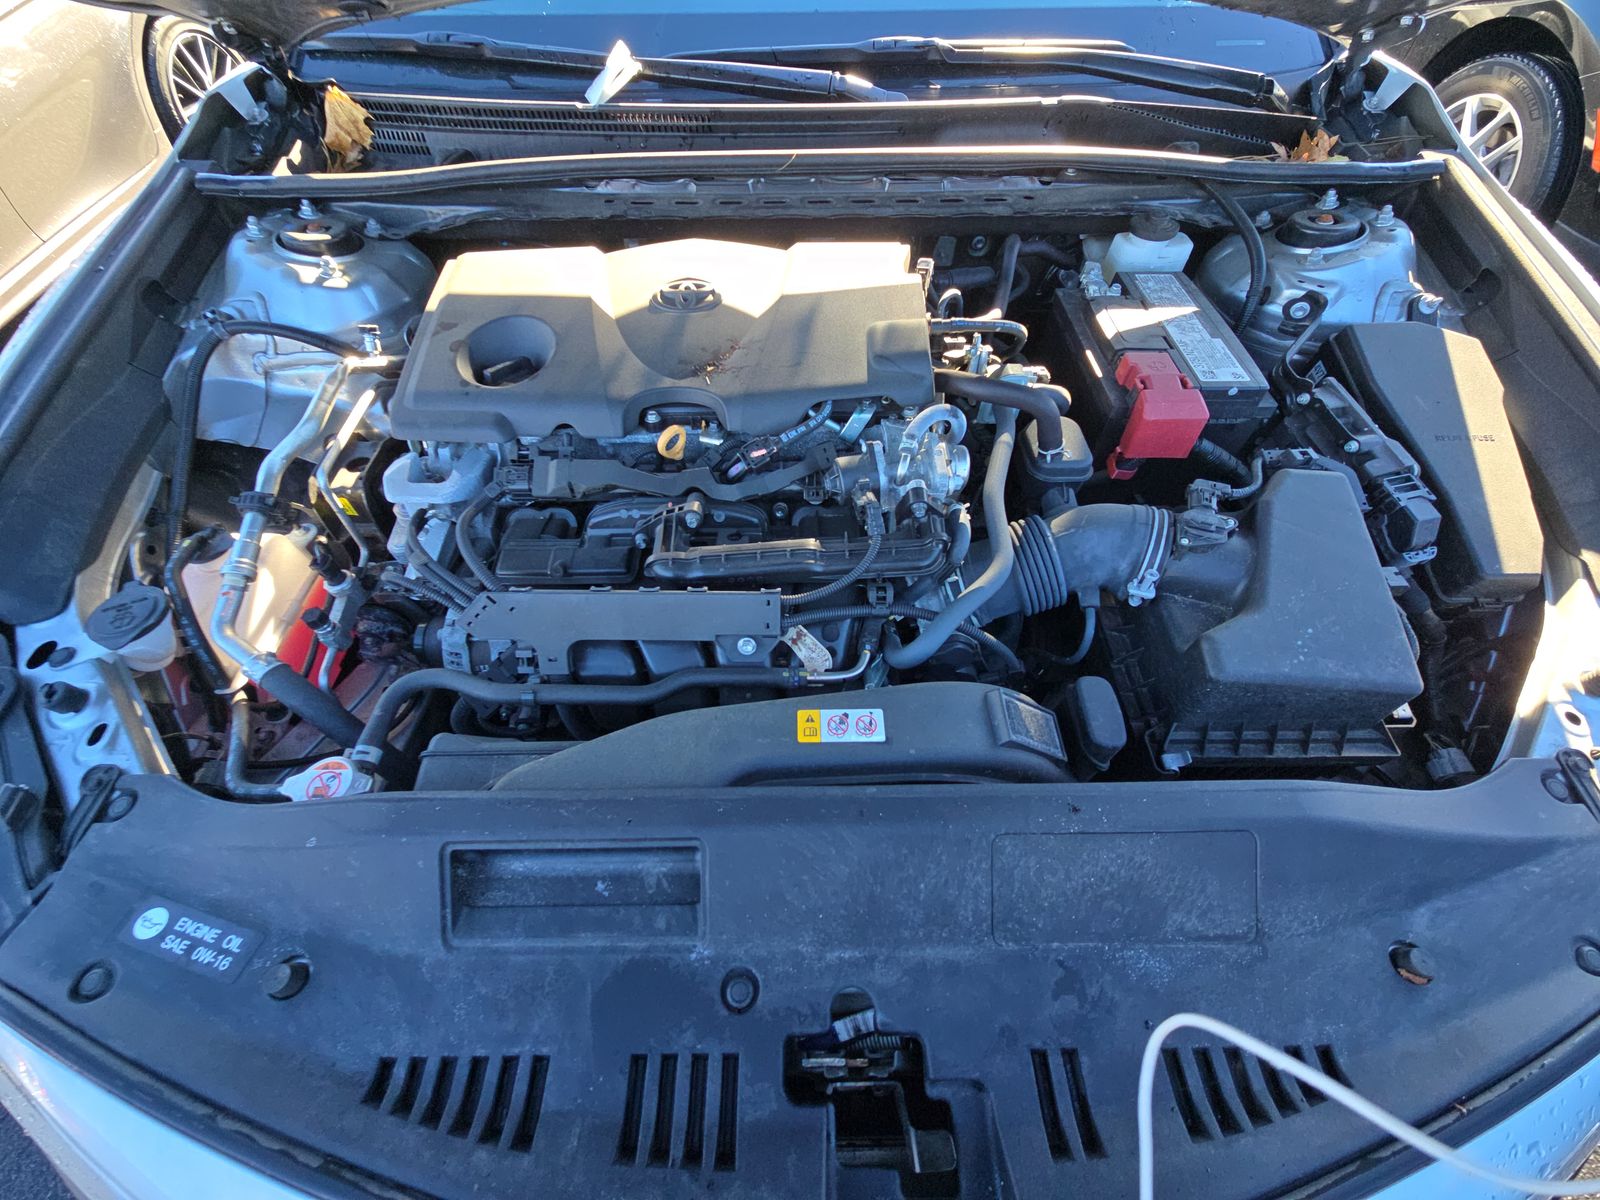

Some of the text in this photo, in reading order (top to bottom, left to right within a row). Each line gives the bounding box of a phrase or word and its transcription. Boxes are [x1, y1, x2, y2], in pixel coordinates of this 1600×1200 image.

[1509, 75, 1540, 121] MICHELIN
[160, 935, 233, 971] SAE 0W-16
[173, 917, 244, 953] ENGINE OIL
